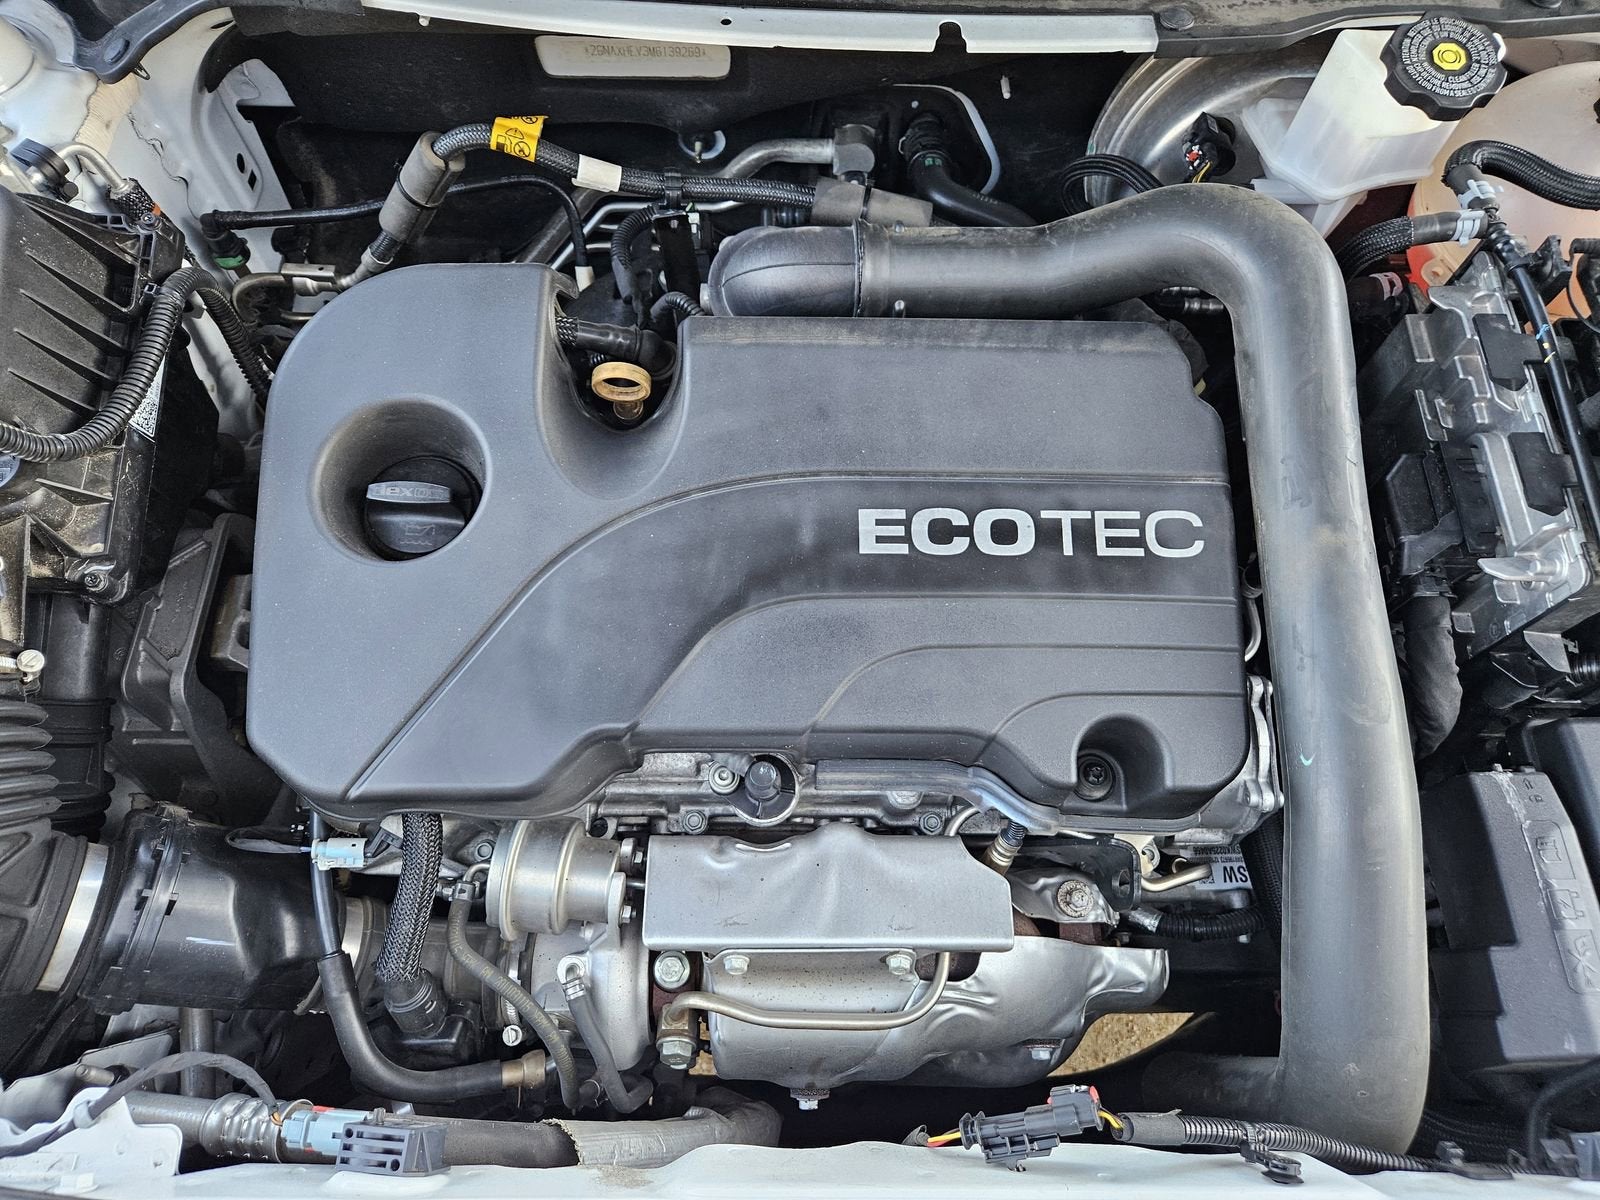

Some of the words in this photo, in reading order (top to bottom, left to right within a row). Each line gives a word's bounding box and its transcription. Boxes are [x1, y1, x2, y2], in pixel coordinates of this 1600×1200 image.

[1431, 17, 1439, 25] LE
[1413, 62, 1425, 75] CAP
[1422, 71, 1441, 87] BEFORE
[1416, 75, 1434, 90] FLUID
[1431, 85, 1450, 96] FROM
[1455, 88, 1477, 97] SEALED
[858, 507, 1204, 557] ECOTEC
[1223, 865, 1249, 883] SW
